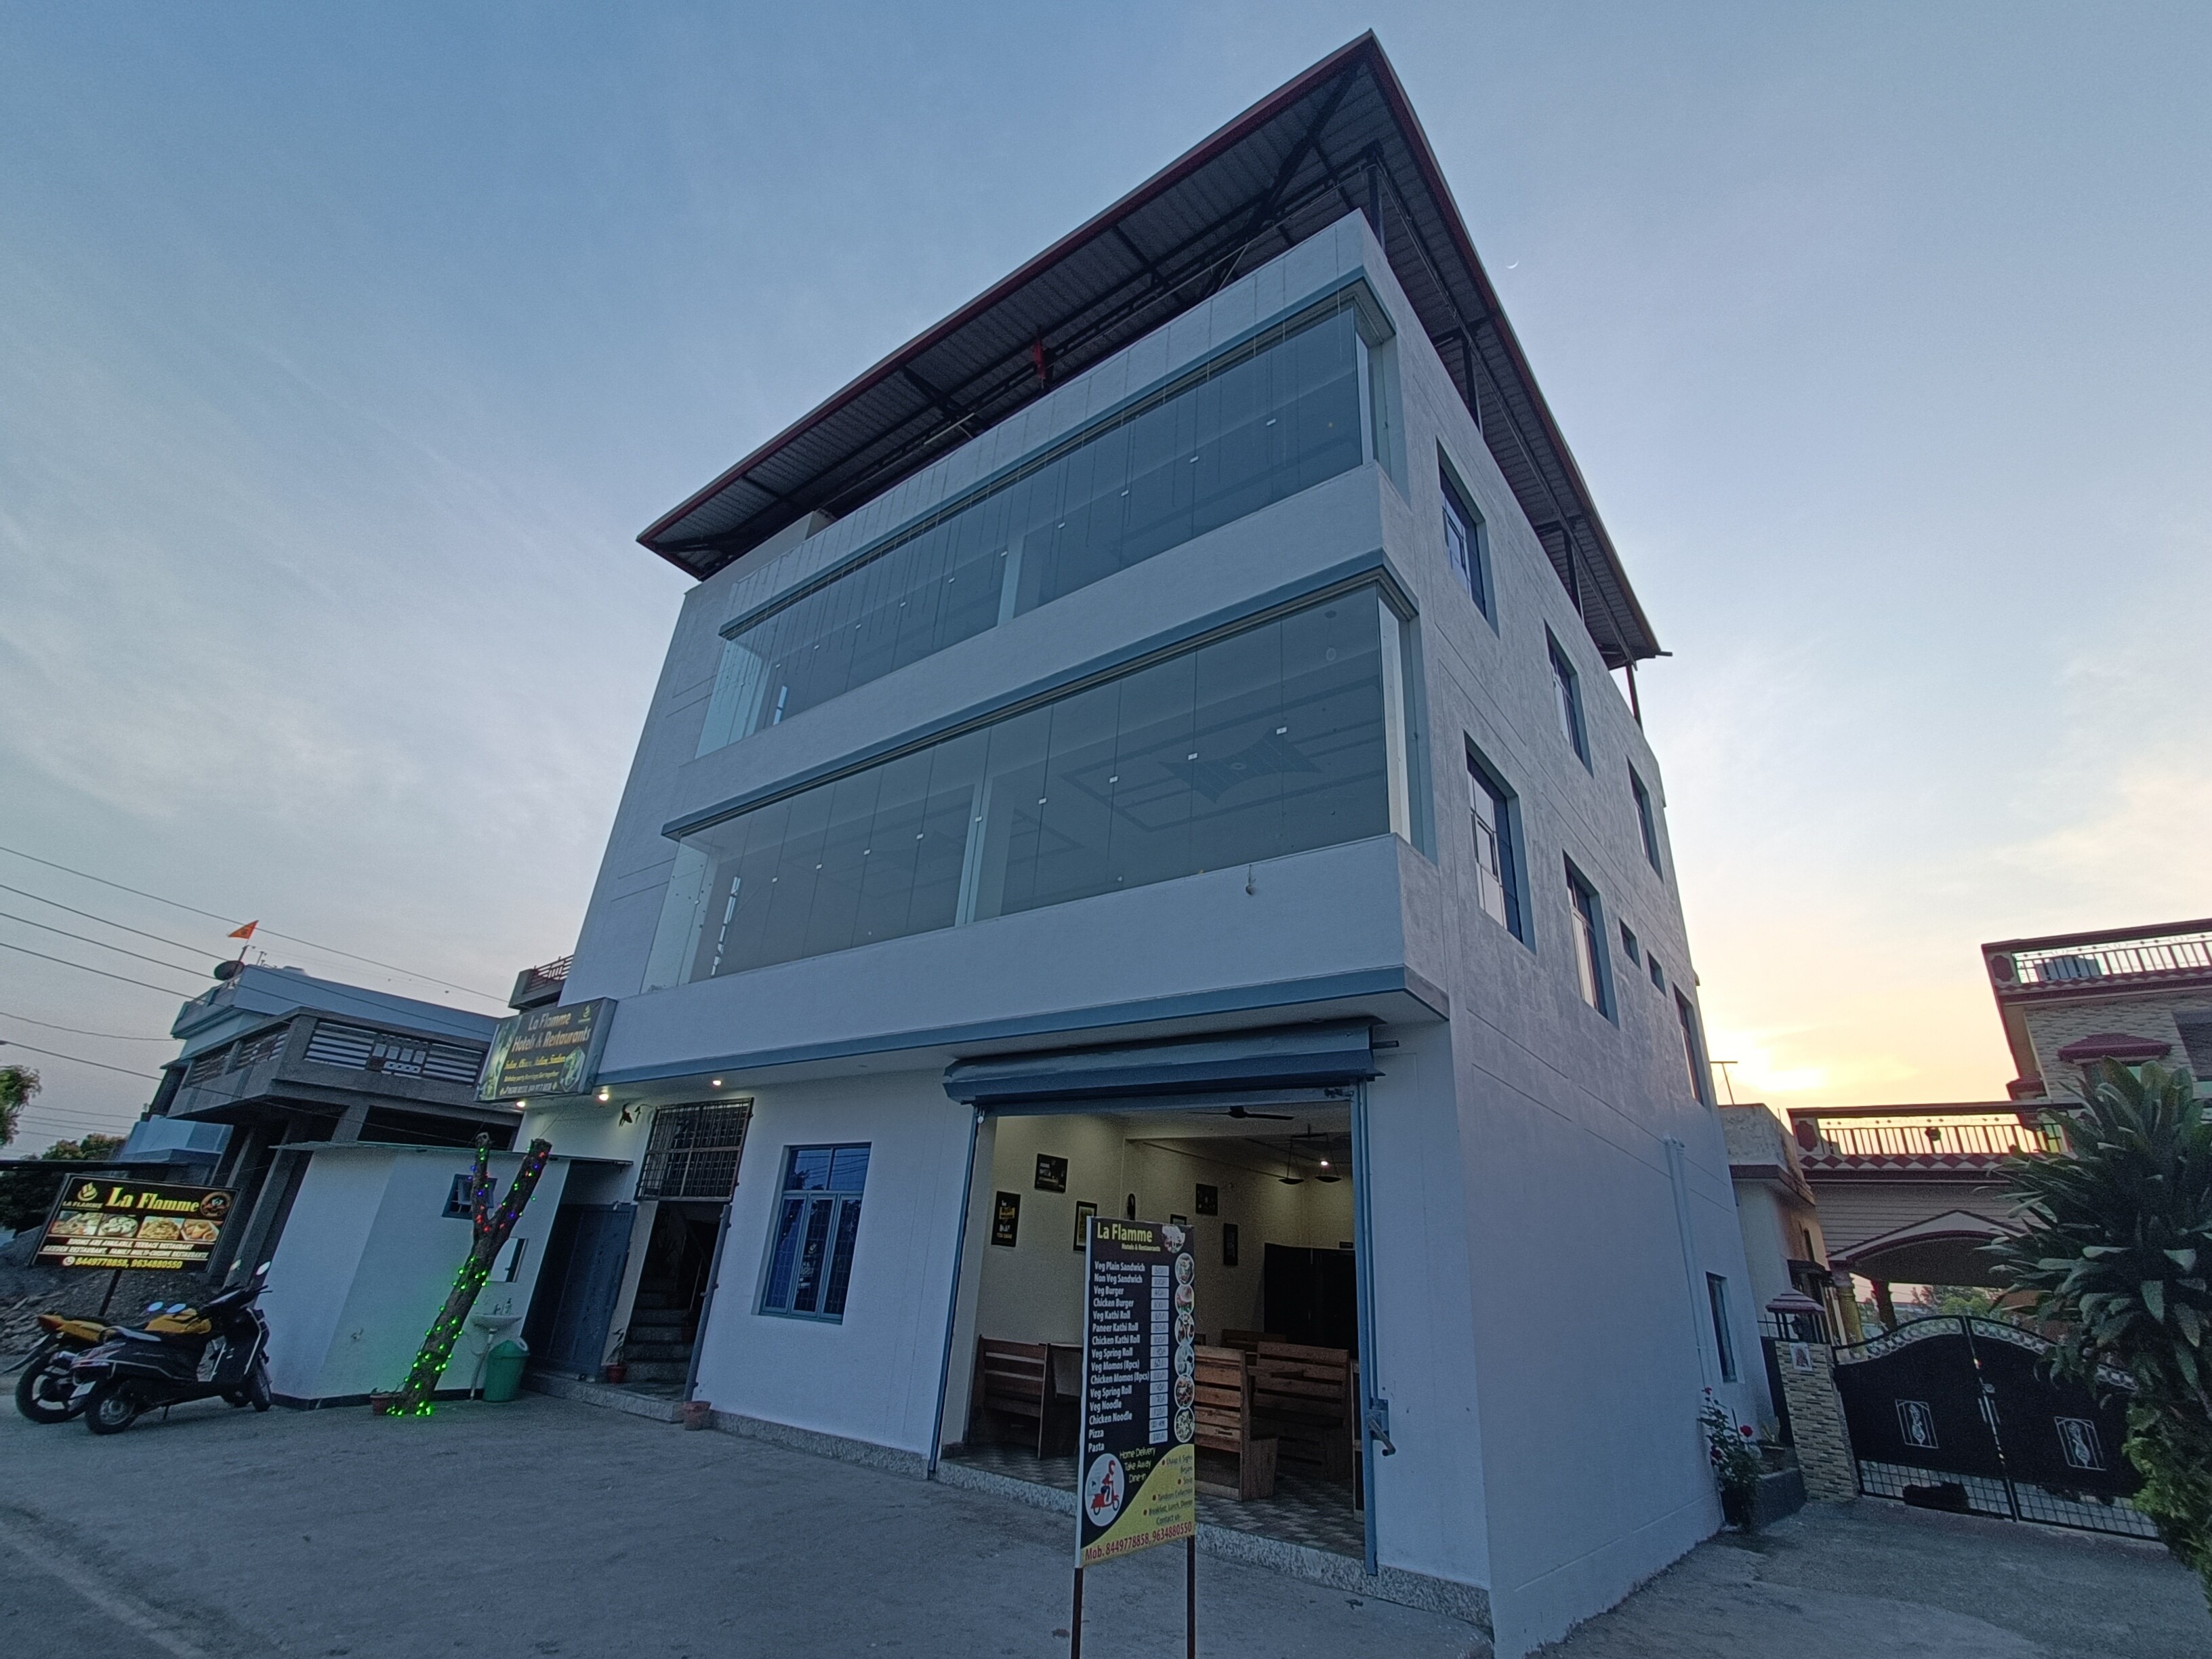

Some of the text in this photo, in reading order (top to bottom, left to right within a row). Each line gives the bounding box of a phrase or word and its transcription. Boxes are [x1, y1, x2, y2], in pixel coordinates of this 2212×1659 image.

[529, 1012, 571, 1031] La Flamme
[512, 1026, 592, 1052] Hotels & Restaurants
[106, 1187, 200, 1212] La Flamme
[1097, 1222, 1153, 1243] La Flamme
[75, 1257, 184, 1269] 8449778858, 9634880550
[1094, 1261, 1145, 1272] Veg Plain Sandwich
[1094, 1273, 1143, 1284] Non Veg Sandwich
[1094, 1286, 1124, 1297] Veg Burger
[1093, 1298, 1134, 1309] Chicken Burger
[1093, 1310, 1130, 1322] Veg Kathi Roll
[1092, 1322, 1139, 1332] Paneer Kathi Roll
[1092, 1334, 1141, 1345] Chicken Kathi Roll
[1092, 1347, 1133, 1360] Veg Spring Roll
[1091, 1362, 1102, 1373] Veg
[1103, 1361, 1123, 1370] Momos
[1090, 1374, 1113, 1385] Chicken
[1113, 1373, 1133, 1382] Momos
[1090, 1385, 1132, 1399] Veg Spring Roll
[1090, 1399, 1122, 1413] Veg Noodle
[1089, 1411, 1132, 1425] Chicken Noodle
[1088, 1429, 1104, 1439] Pizza
[1088, 1443, 1105, 1453] Pasta
[1120, 1447, 1156, 1459] Home Delivery
[1124, 1460, 1151, 1471] Take Away
[1086, 1521, 1192, 1561] Mob. 8449778858, 9634880550
